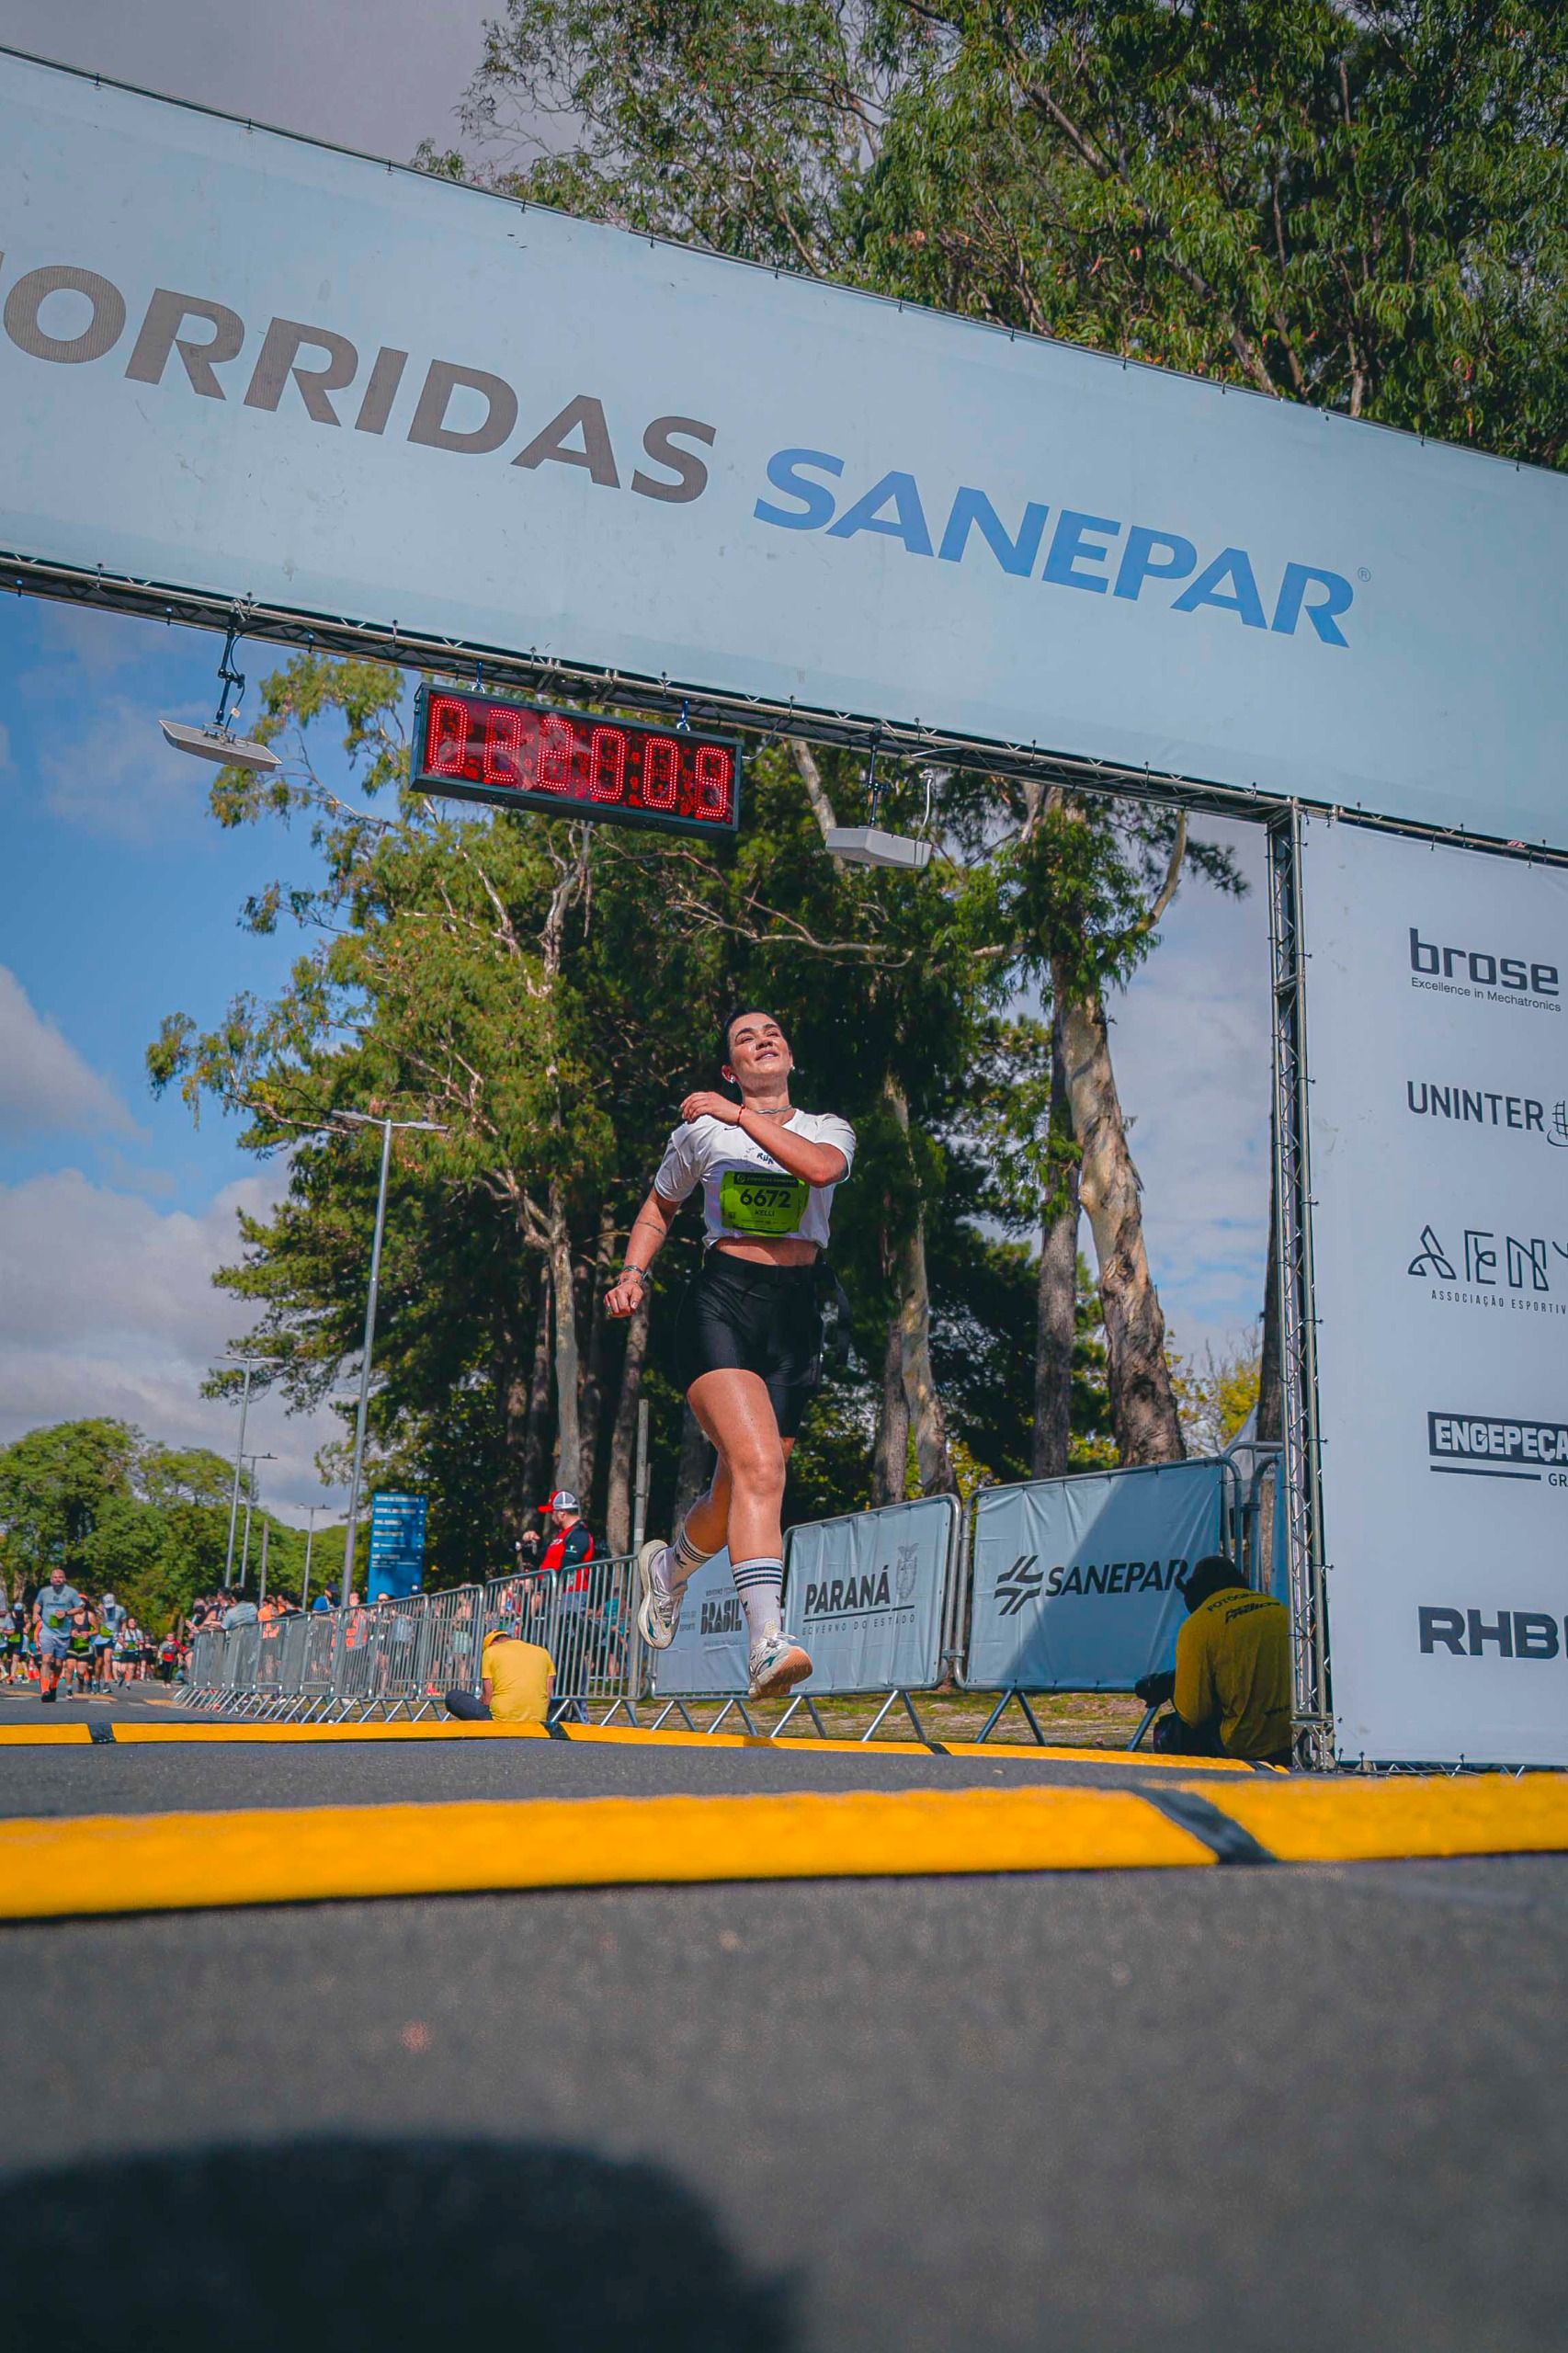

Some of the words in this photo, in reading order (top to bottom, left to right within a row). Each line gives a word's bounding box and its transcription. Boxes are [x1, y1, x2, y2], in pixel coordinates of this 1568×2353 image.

[0, 250, 716, 504] ORRIDAS
[753, 448, 1354, 648] SANEPAR
[1409, 927, 1560, 996] brose
[1411, 976, 1471, 996] Excellence
[1474, 988, 1484, 999] in
[1487, 990, 1562, 1012] Mechatronics
[1407, 1080, 1544, 1132] UNINTER
[740, 1188, 792, 1209] 6672
[1431, 1290, 1505, 1307] ASSOCIAÇÃO
[804, 1564, 891, 1615] PARANÁ
[1045, 1559, 1188, 1597] SANEPAR
[700, 1598, 743, 1635] BRASIL
[853, 1620, 868, 1631] DO
[873, 1614, 915, 1628] ESTADO
